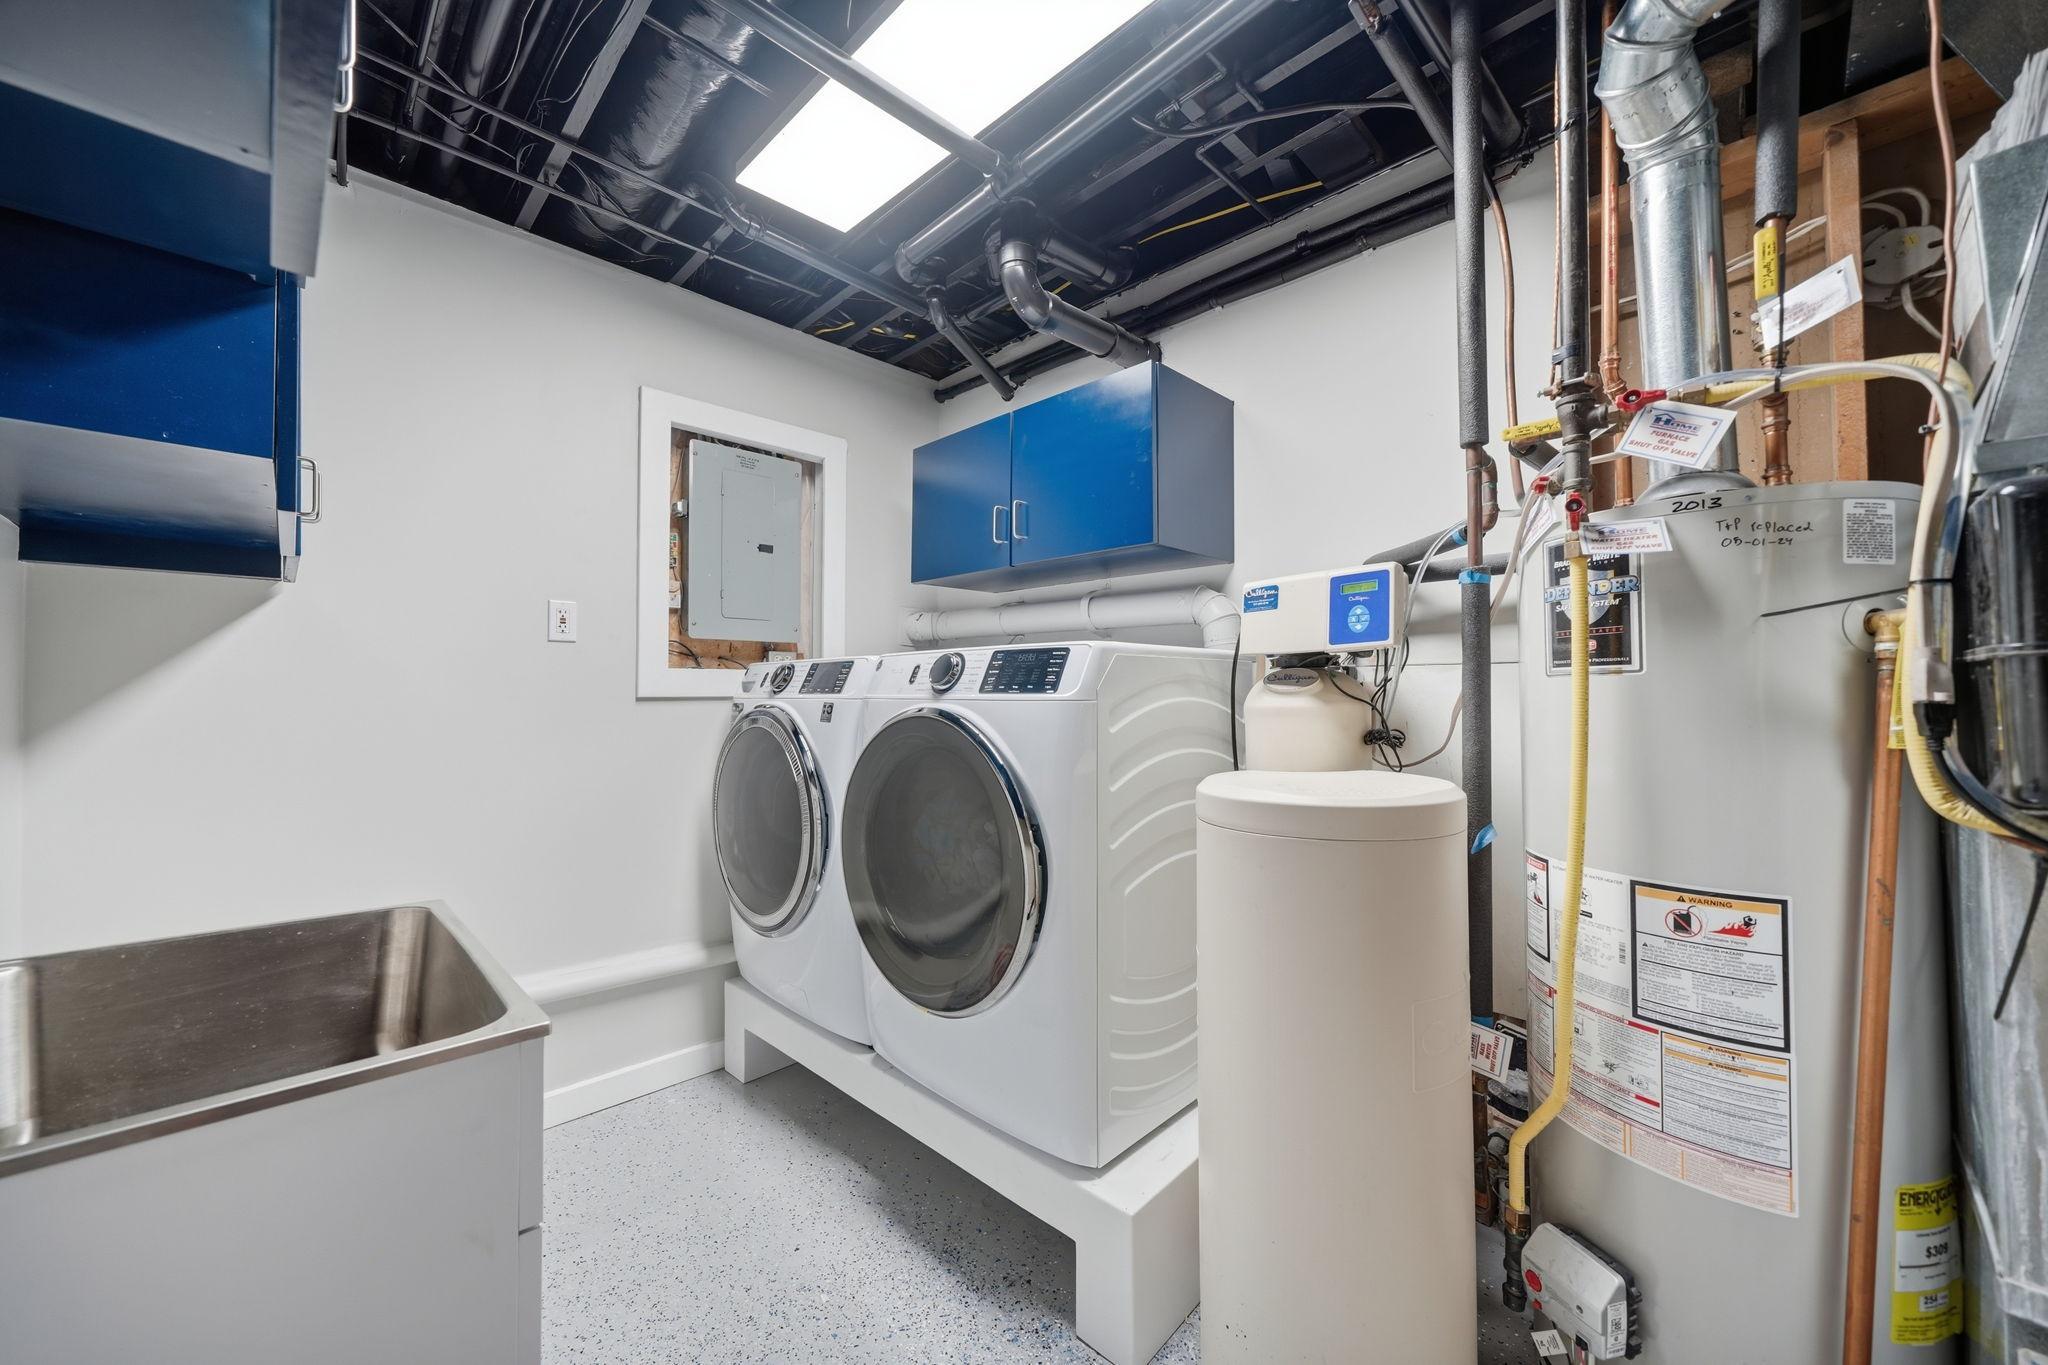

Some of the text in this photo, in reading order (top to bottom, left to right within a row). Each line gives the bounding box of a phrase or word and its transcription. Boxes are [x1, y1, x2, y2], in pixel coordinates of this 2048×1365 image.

[1650, 430, 1691, 442] FURNACE
[1658, 438, 1675, 446] GAS
[1628, 440, 1698, 458] SHUT OFF VALVE
[1672, 497, 1723, 513] 2013
[1266, 673, 1316, 683] Culligan
[1688, 896, 1733, 909] WARNING
